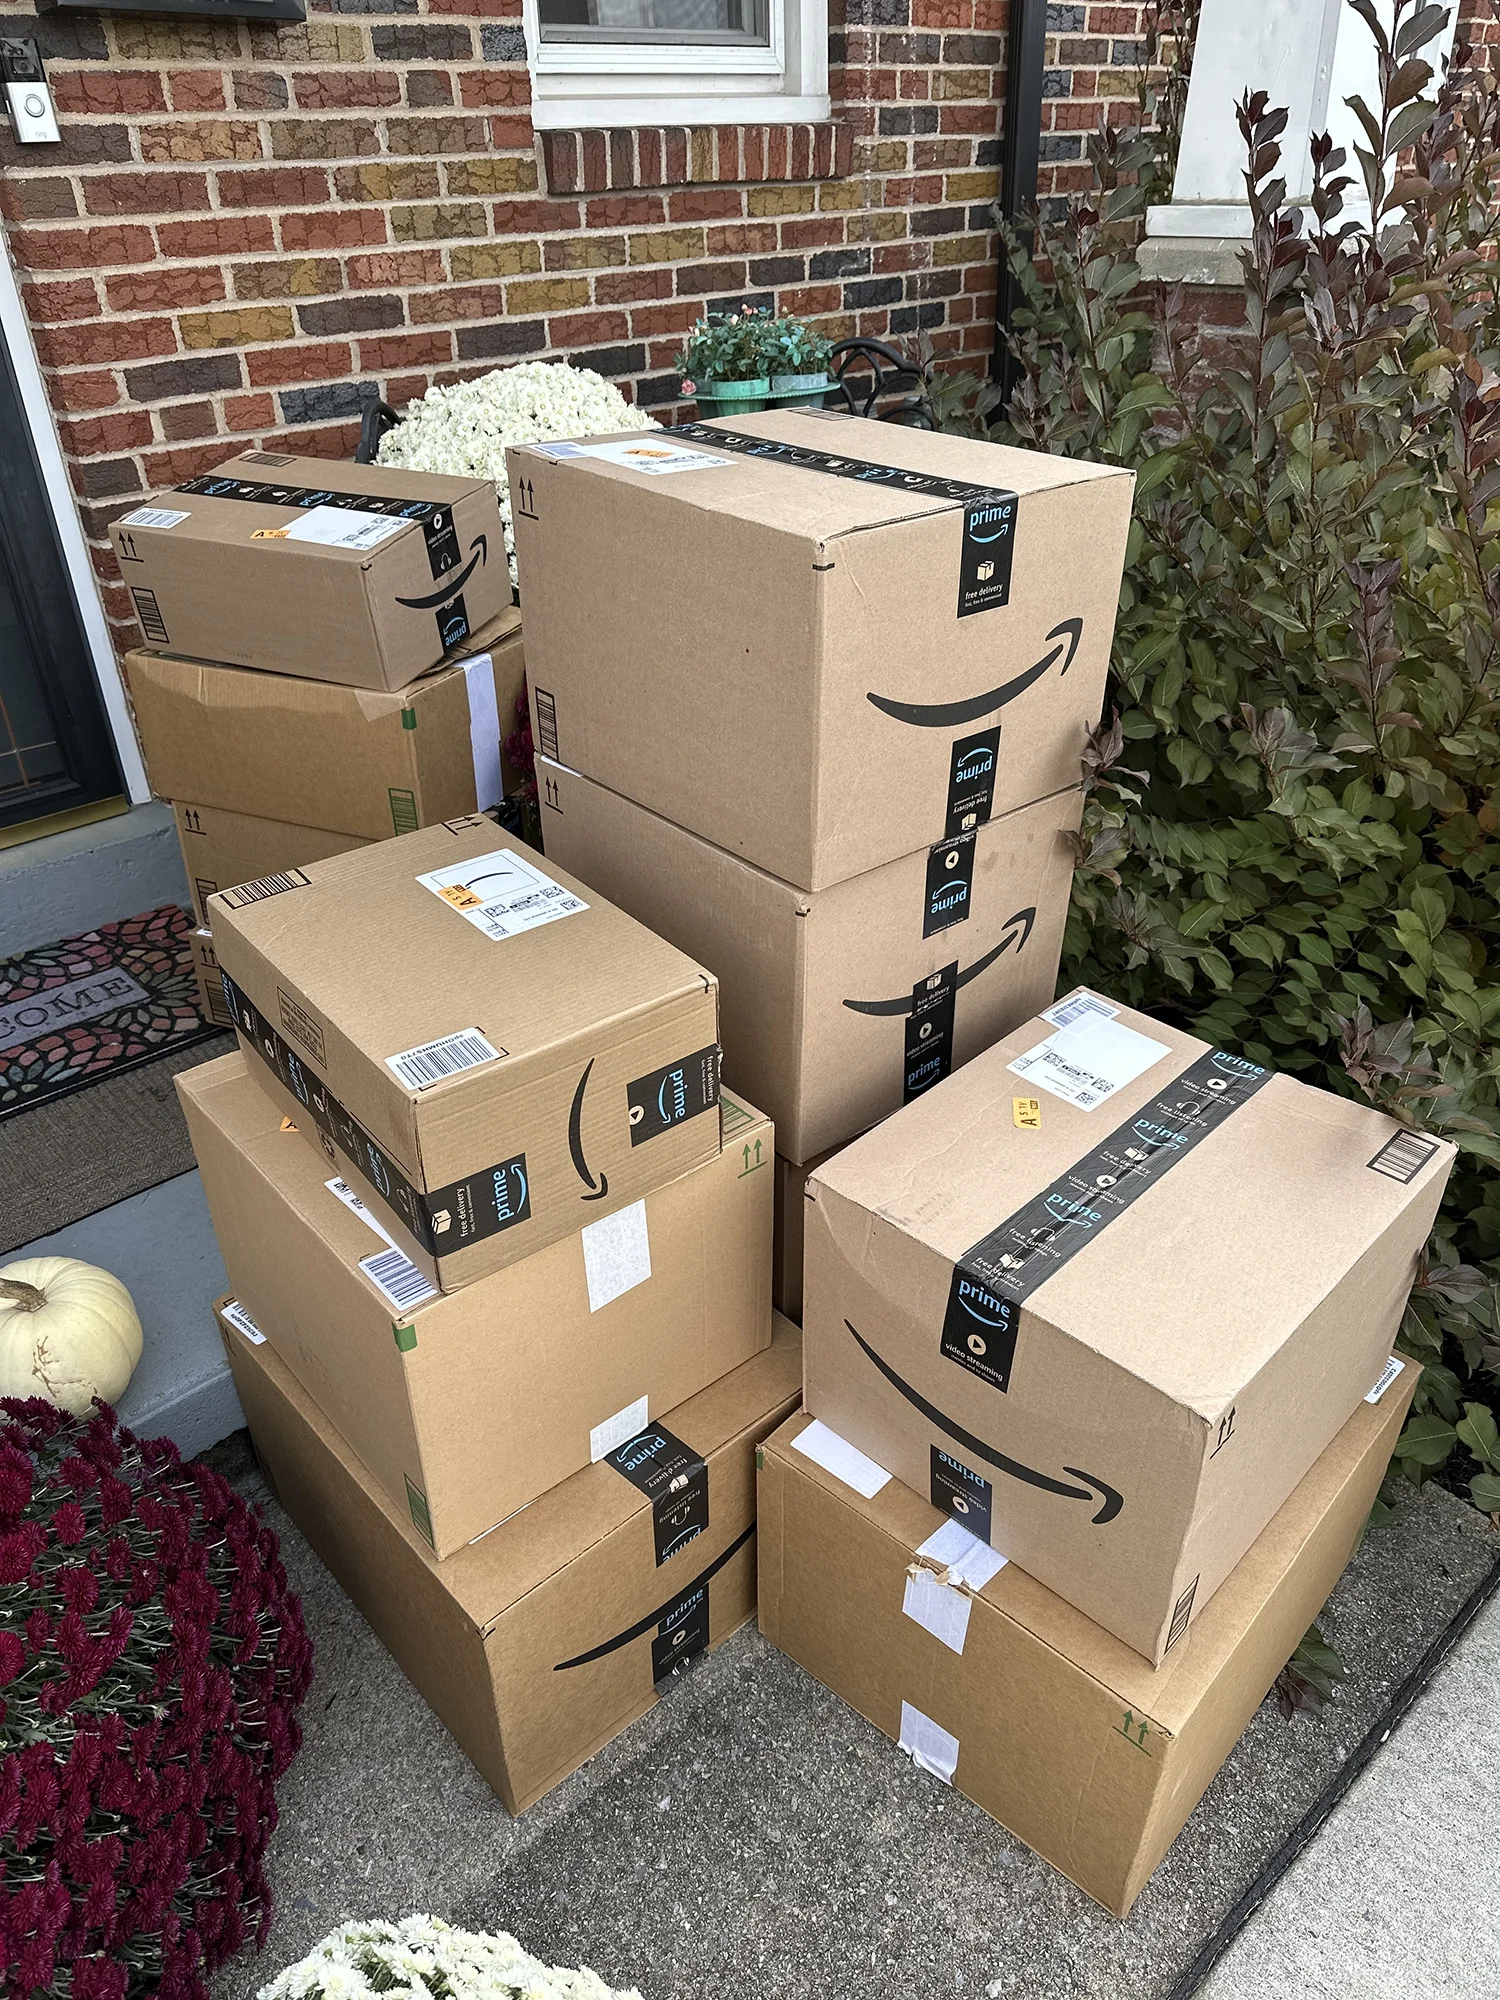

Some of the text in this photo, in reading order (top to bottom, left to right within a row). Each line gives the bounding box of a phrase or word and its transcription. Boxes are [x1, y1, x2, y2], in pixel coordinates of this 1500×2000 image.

[35, 131, 47, 139] ring
[969, 504, 1012, 532] prime
[965, 584, 1003, 600] free delivery
[445, 621, 467, 647] prime
[955, 755, 993, 783] prime
[953, 801, 976, 814] delivery
[976, 795, 988, 805] free
[460, 897, 477, 905] A
[931, 886, 968, 914] prime
[908, 1056, 941, 1086] prime
[1212, 1051, 1265, 1075] prime
[669, 1068, 688, 1119] prime
[1181, 1079, 1200, 1090] video
[1156, 1102, 1173, 1113] free
[1020, 1118, 1038, 1127] A
[1134, 1118, 1189, 1144] prime
[1068, 1175, 1089, 1188] video
[491, 1169, 515, 1222] prime
[456, 1188, 469, 1237] free delivery
[1009, 1228, 1026, 1240] free
[975, 1257, 993, 1269] free
[958, 1279, 1011, 1319] prime
[945, 1343, 1004, 1382] video streaming
[624, 1436, 668, 1471] prime
[674, 1457, 688, 1469] free
[687, 1489, 701, 1502] free
[935, 1472, 968, 1499] streaming
[968, 1496, 987, 1512] video
[666, 1588, 704, 1628] prime
